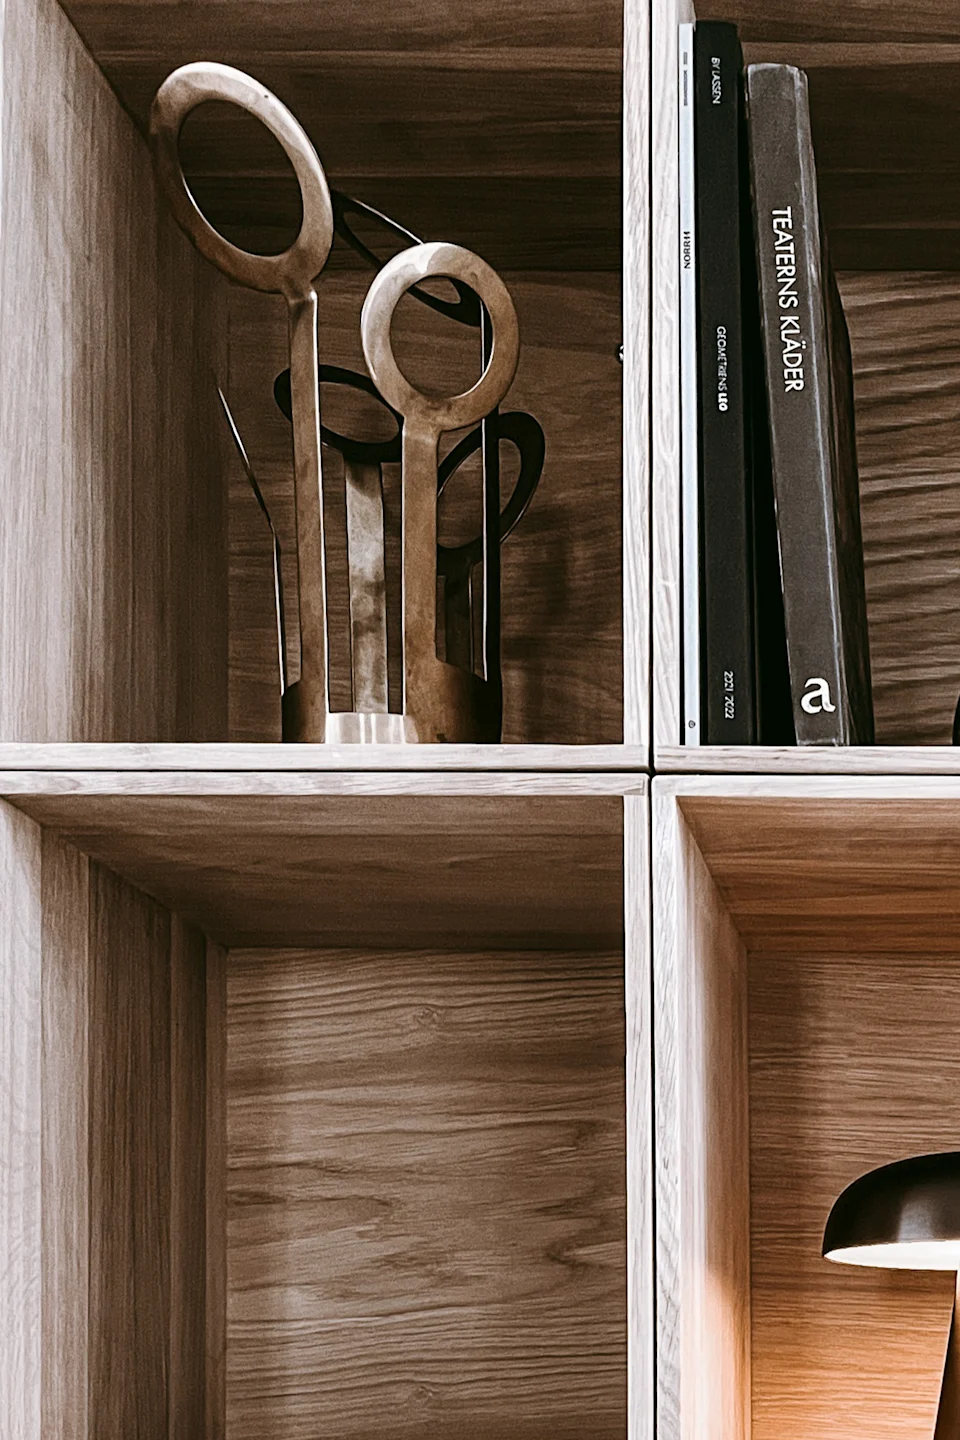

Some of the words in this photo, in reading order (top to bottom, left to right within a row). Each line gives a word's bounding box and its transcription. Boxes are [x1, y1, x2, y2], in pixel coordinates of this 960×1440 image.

[711, 57, 721, 69] BY
[711, 70, 721, 104] LASSEN
[772, 206, 799, 309] TEATERNS
[716, 326, 728, 392] GEOMETRIENS
[779, 315, 807, 393] KLÄDER
[718, 392, 728, 411] LEO
[801, 677, 836, 714] a
